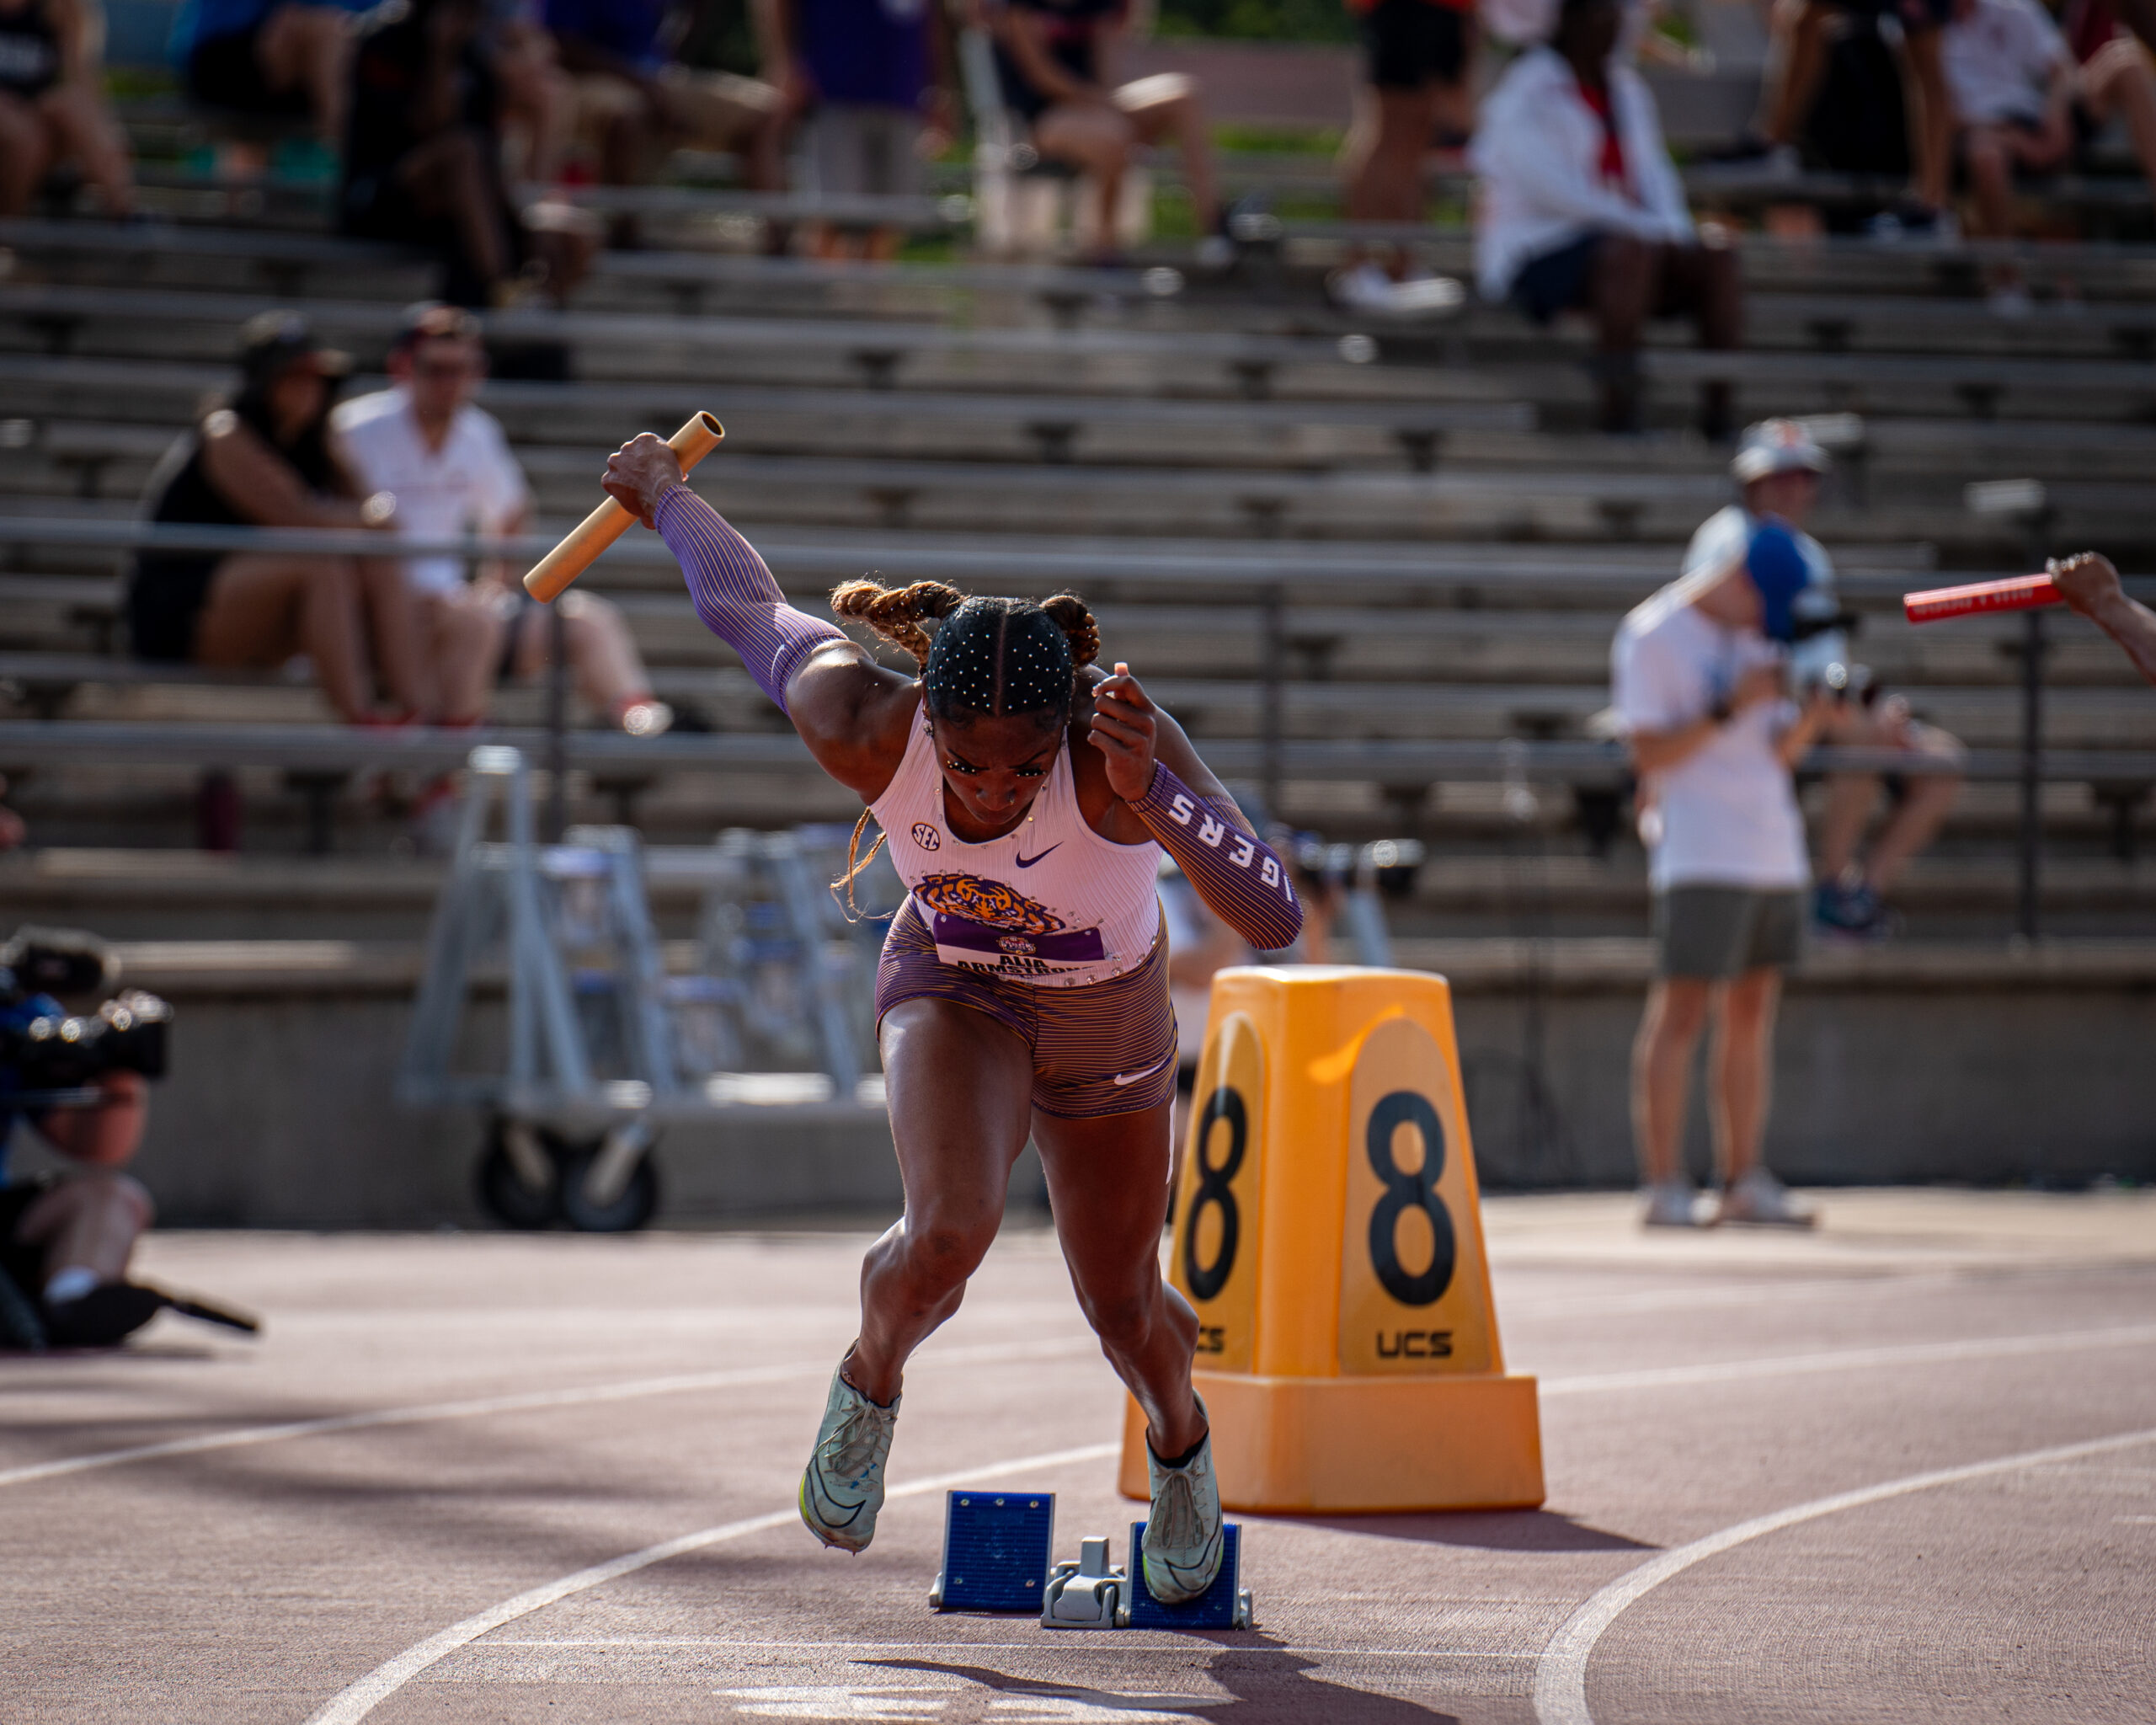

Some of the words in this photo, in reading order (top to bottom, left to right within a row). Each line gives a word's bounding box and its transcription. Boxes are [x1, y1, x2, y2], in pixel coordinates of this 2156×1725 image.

[913, 824, 940, 850] SEC
[1168, 793, 1293, 902] IGERS
[1000, 954, 1049, 968] ALIA
[1184, 1086, 1247, 1300] 8
[1366, 1090, 1457, 1306] 8
[1196, 1327, 1225, 1354] CS
[1376, 1330, 1454, 1358] UCS
